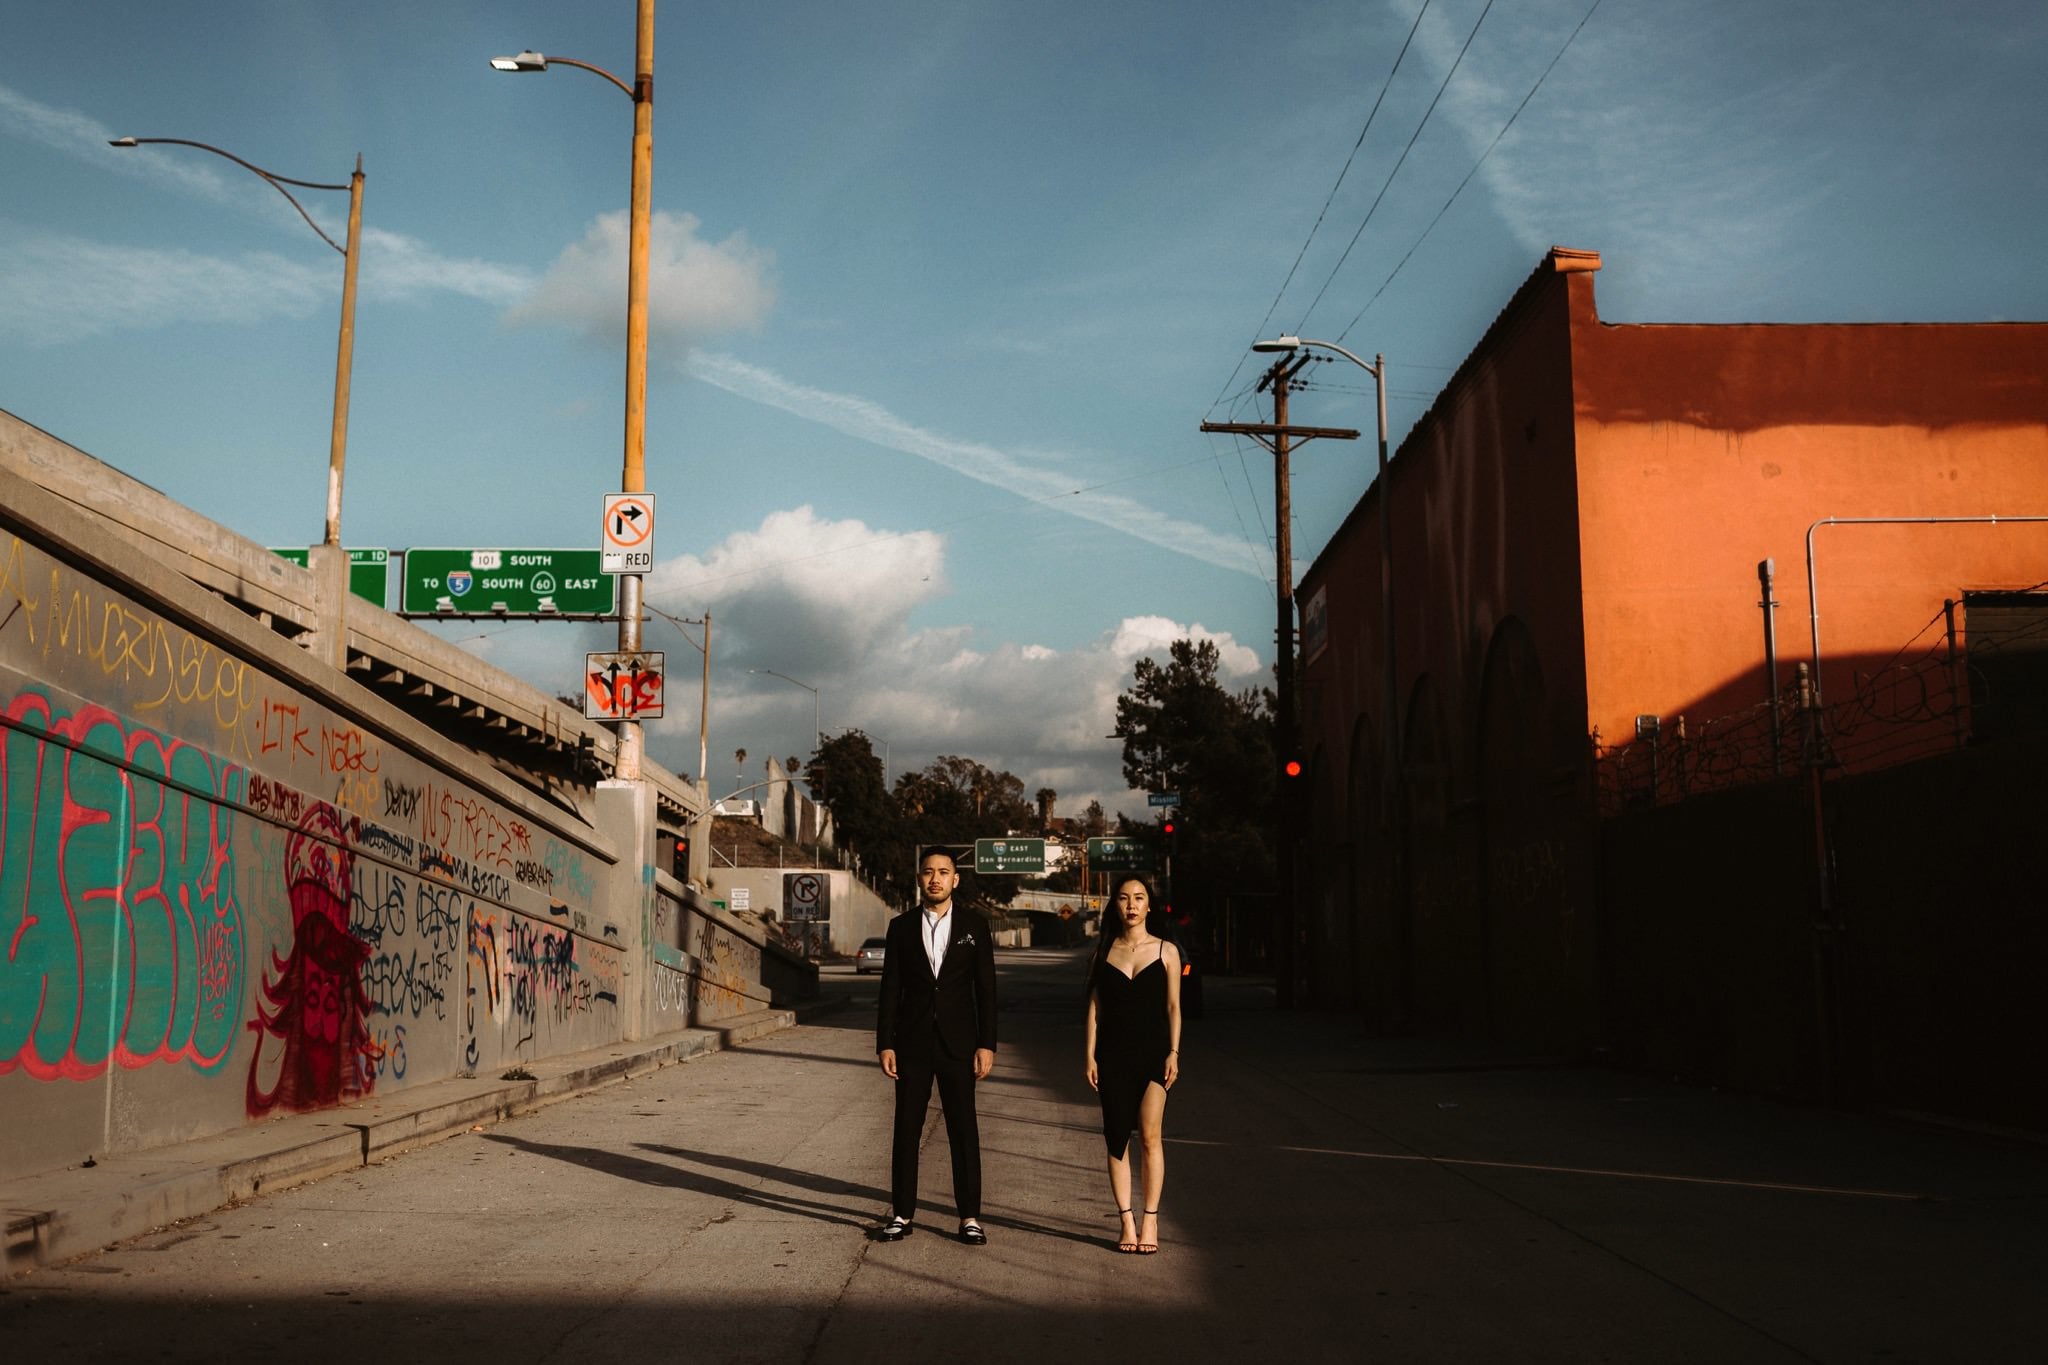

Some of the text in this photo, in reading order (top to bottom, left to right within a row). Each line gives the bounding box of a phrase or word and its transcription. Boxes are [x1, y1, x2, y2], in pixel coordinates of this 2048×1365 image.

[371, 550, 385, 561] 1D
[478, 555, 552, 566] 101 SOUTH
[625, 553, 650, 566] RED
[423, 578, 598, 592] TO 5 SOUTH 60 EAST
[998, 855, 1041, 863] Bernardino
[472, 866, 511, 903] BITCH
[793, 906, 803, 915] ON
